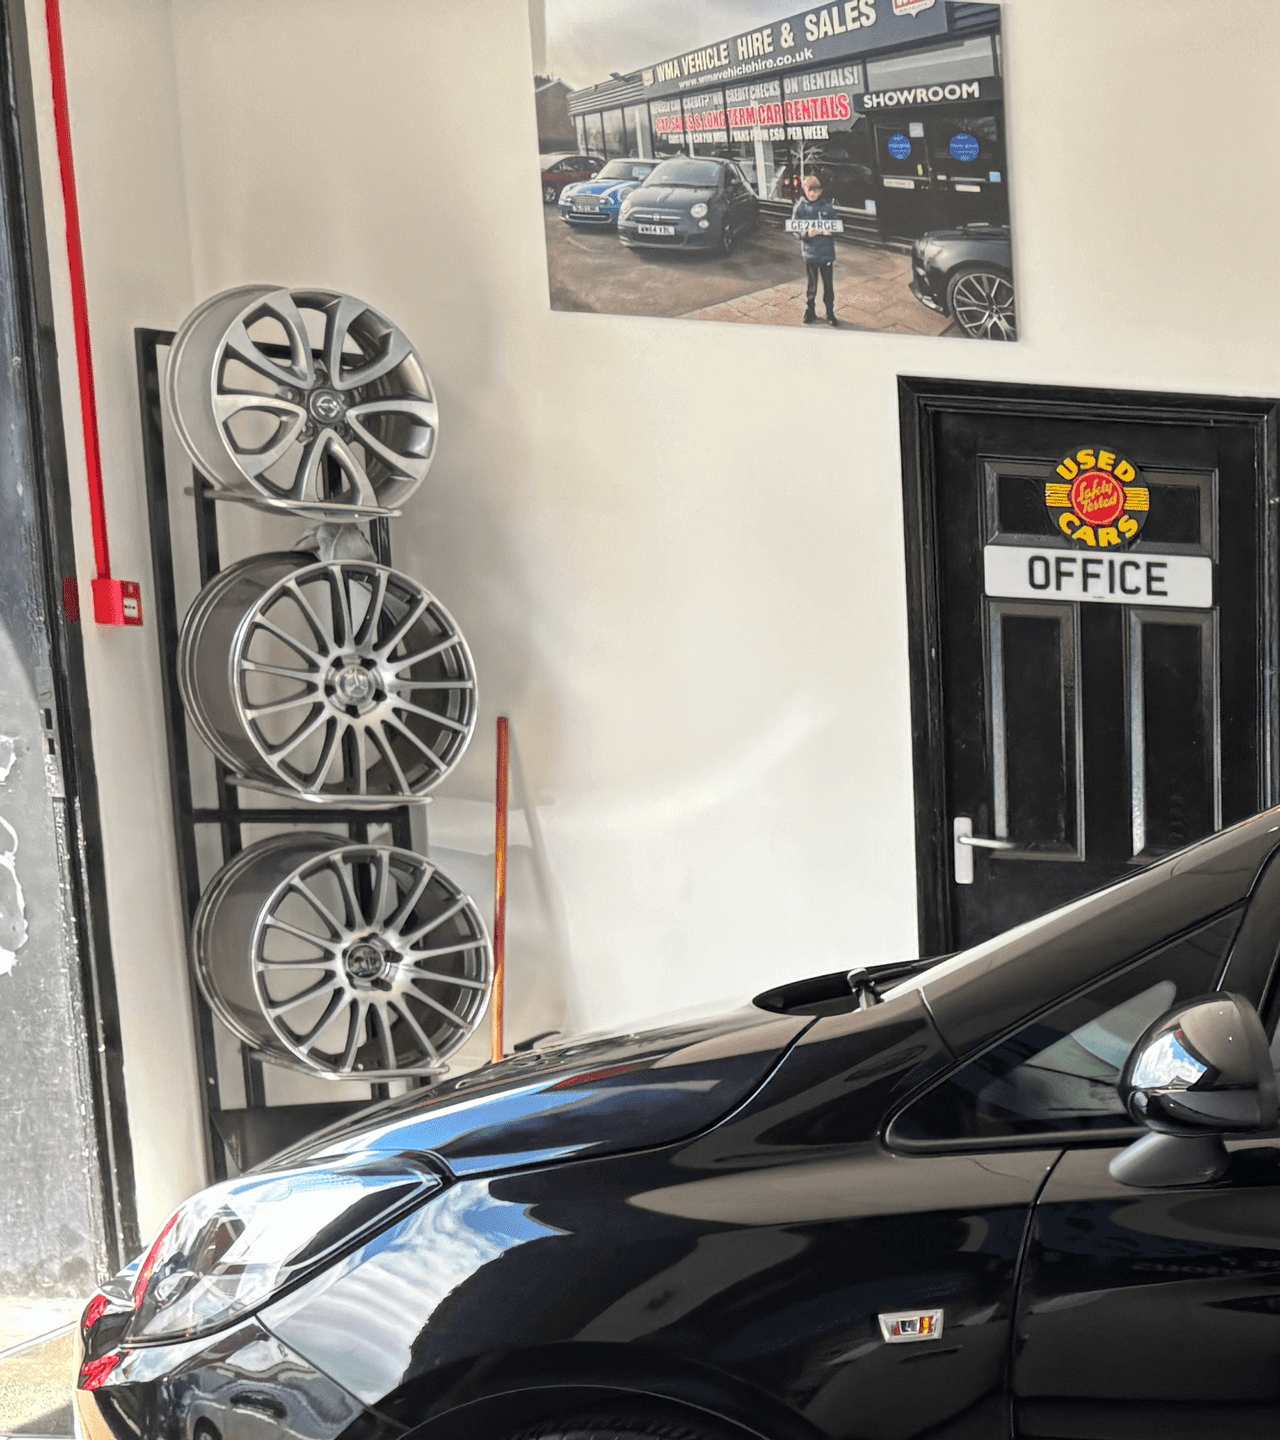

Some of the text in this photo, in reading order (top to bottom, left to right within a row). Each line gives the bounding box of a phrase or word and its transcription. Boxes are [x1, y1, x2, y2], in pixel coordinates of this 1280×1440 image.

[656, 0, 877, 83] WMA VEHICLE HIRE & SALES
[750, 81, 781, 99] CHECKS
[784, 77, 799, 94] ON
[802, 65, 860, 93] RENTALS!
[864, 81, 980, 108] SHOWROOM
[757, 103, 784, 126] CAR
[784, 93, 851, 123] RENTALS
[787, 126, 803, 140] PER
[803, 125, 829, 140] WEEK
[1056, 449, 1136, 482] USED
[1059, 512, 1139, 547] CARS
[1028, 555, 1168, 597] OFFICE
